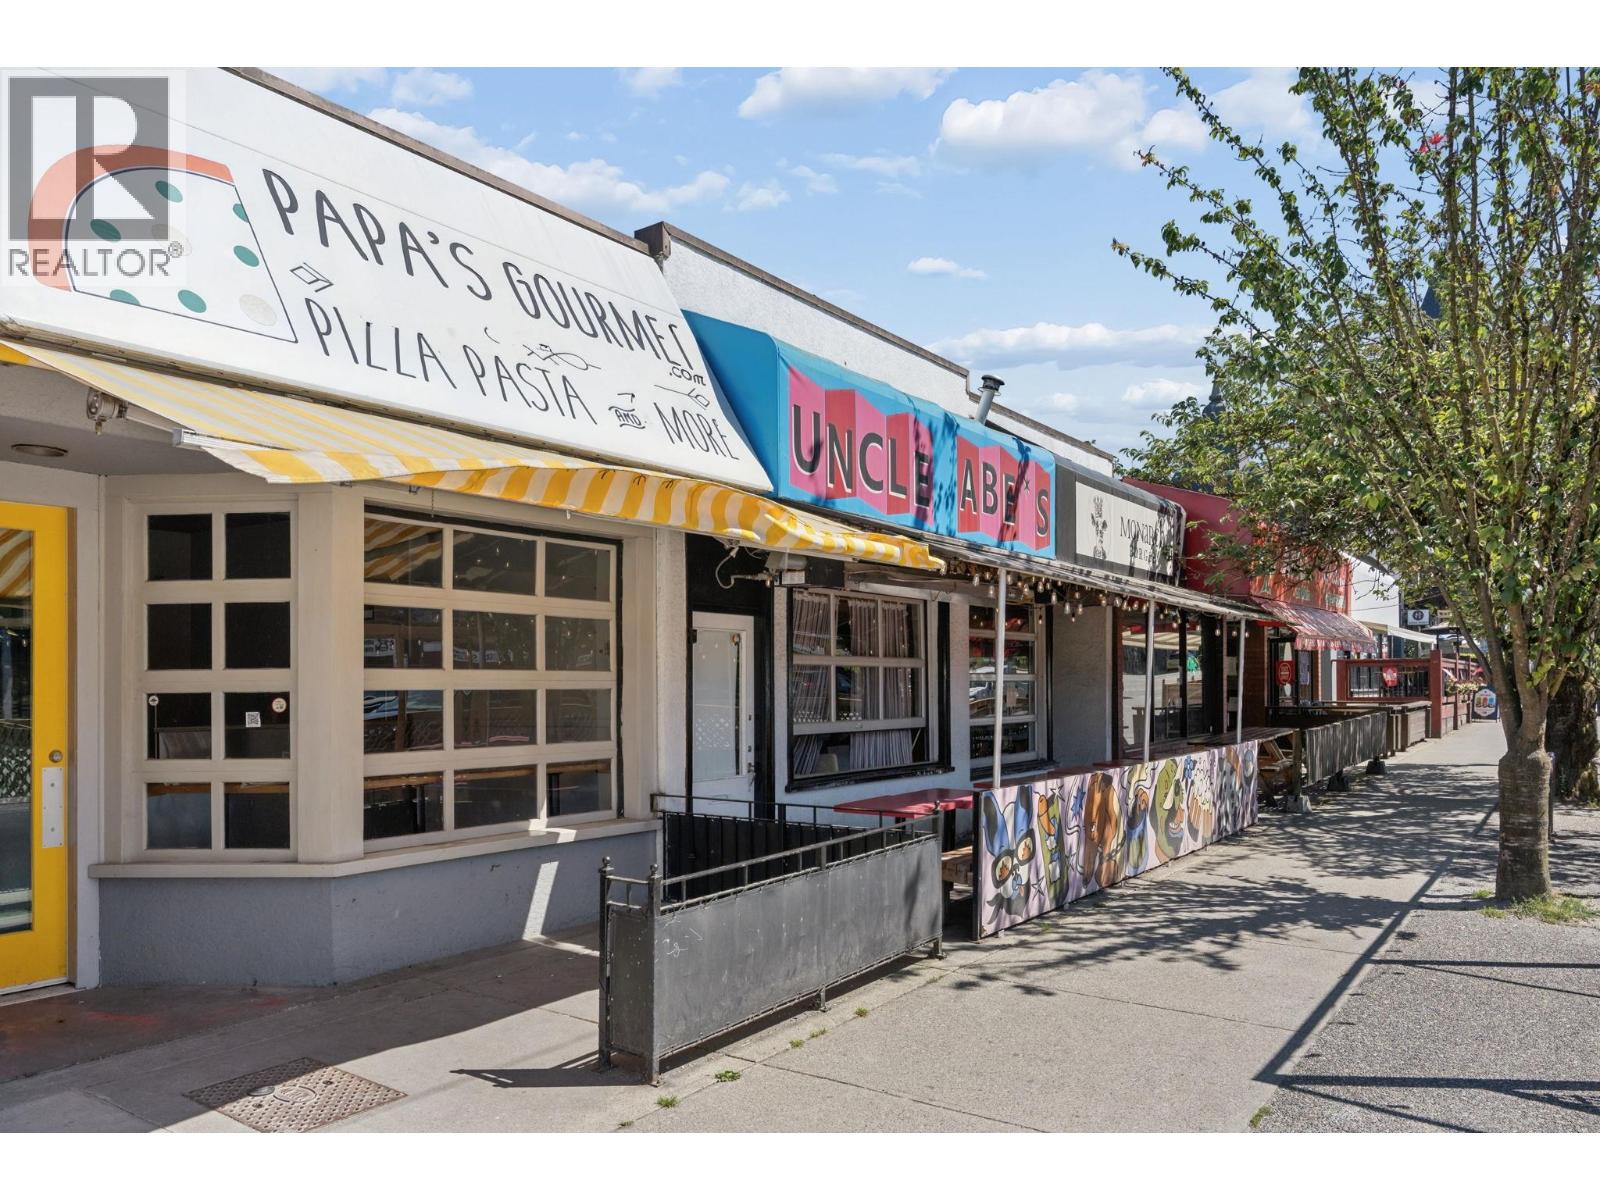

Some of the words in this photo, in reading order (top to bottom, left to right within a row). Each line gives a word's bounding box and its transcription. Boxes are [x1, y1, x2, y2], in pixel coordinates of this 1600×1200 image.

[262, 168, 493, 301] PAPA'S
[462, 344, 598, 425] PASTA
[653, 402, 740, 460] MORE
[669, 366, 707, 386] .com
[791, 404, 930, 508] UNCLE
[959, 458, 1049, 538] ABE'S
